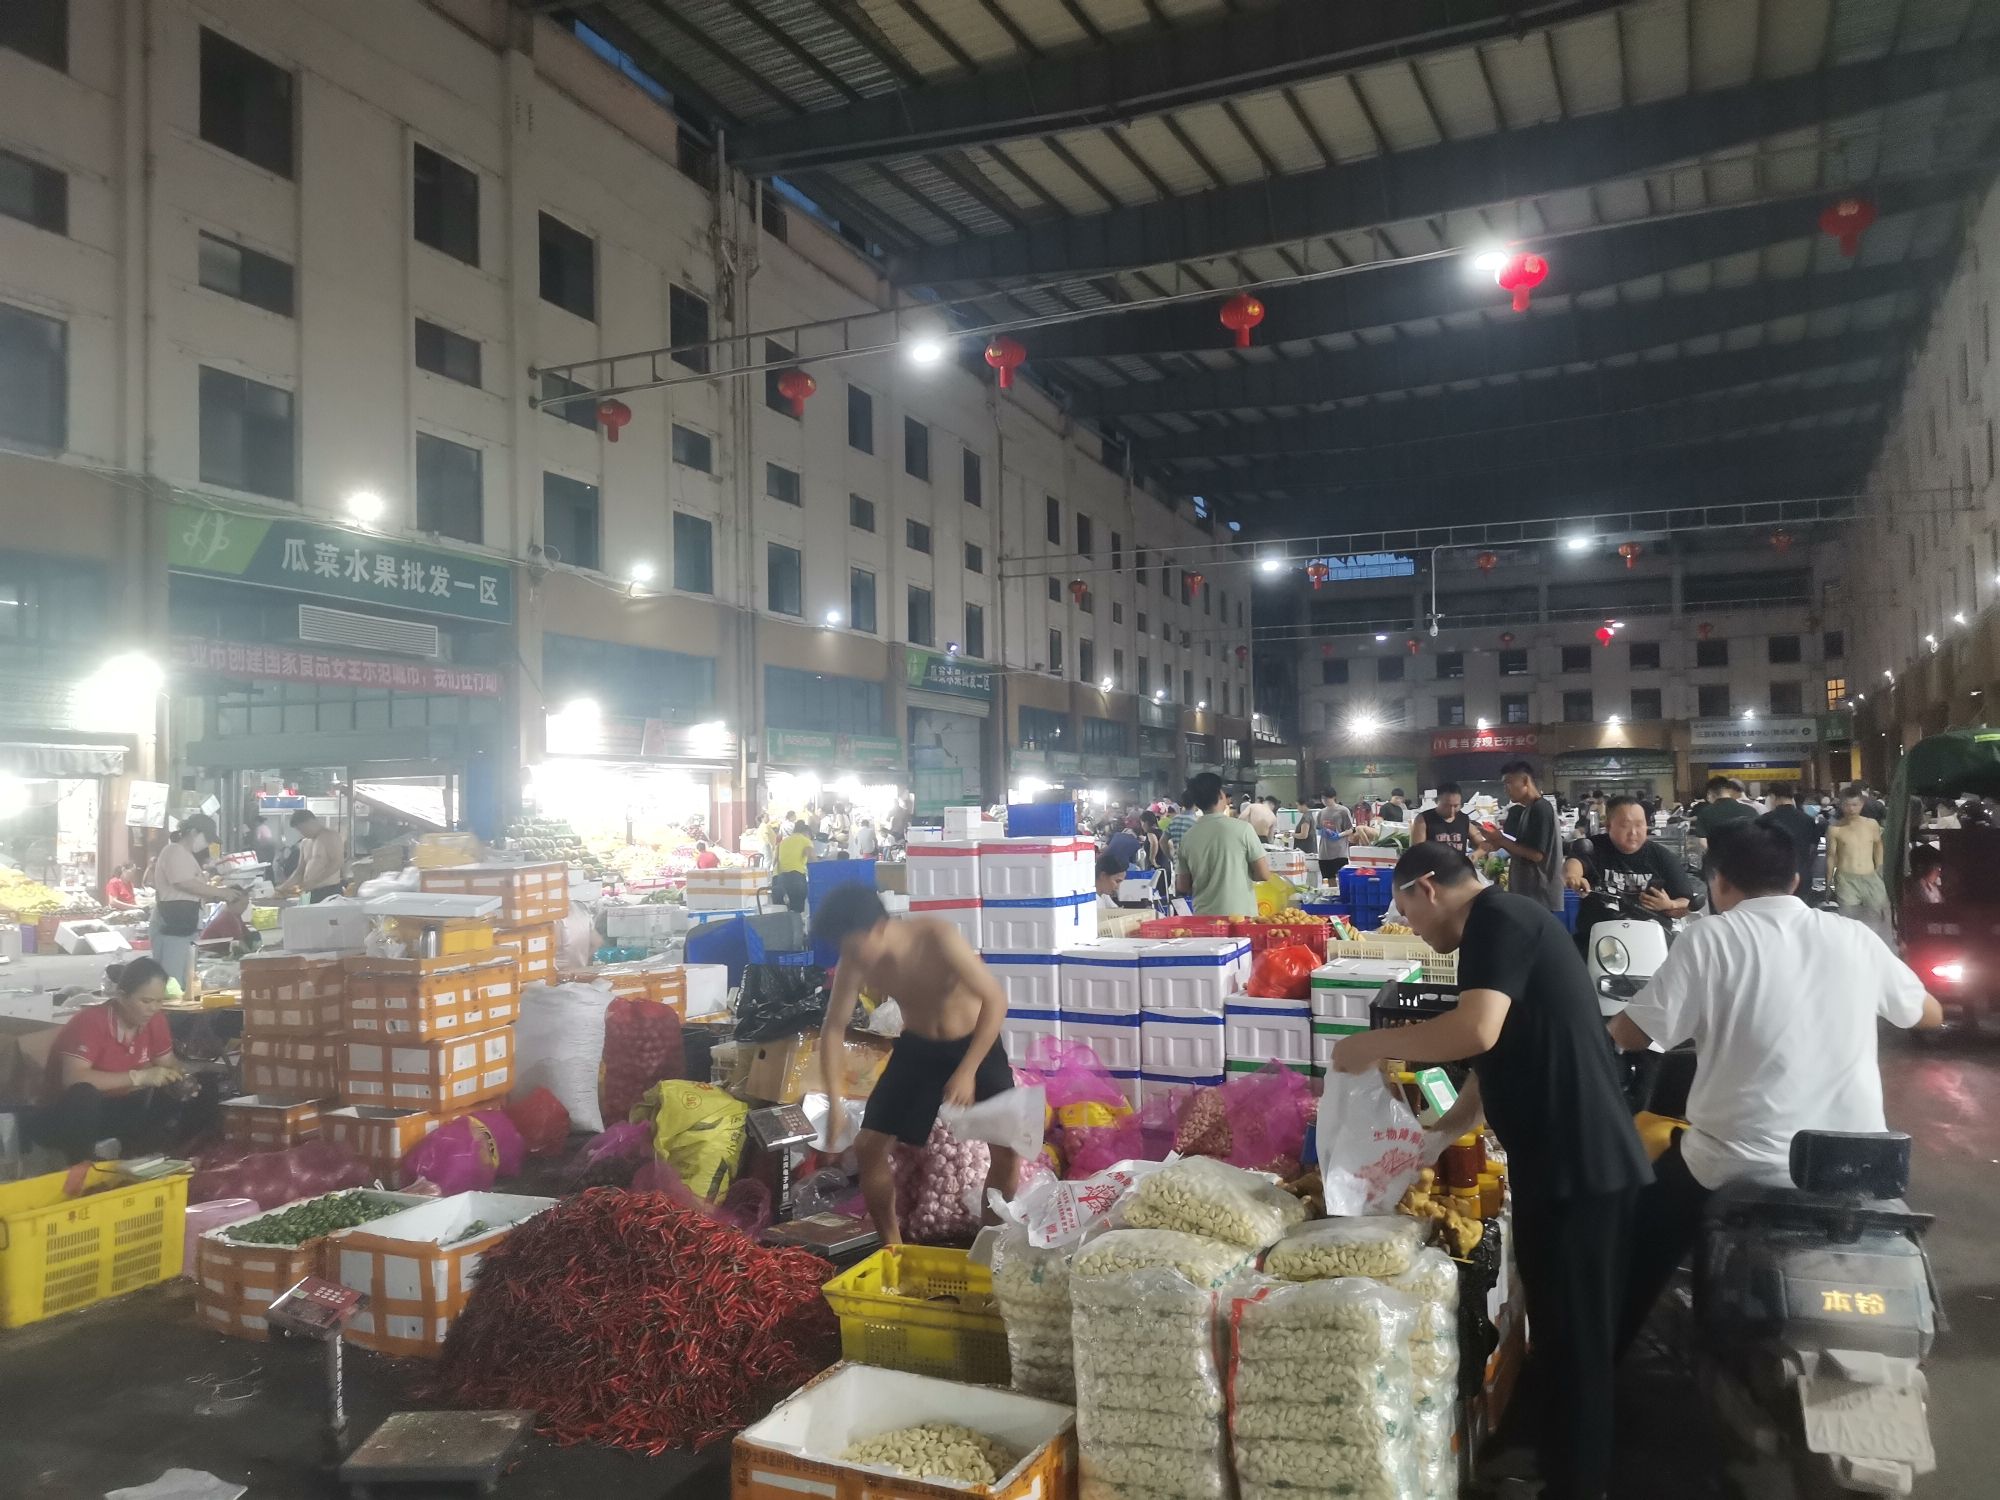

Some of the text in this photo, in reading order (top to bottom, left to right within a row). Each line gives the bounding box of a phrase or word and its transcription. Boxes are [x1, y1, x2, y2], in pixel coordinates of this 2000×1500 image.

[281, 538, 498, 605] 瓜菜水果批发一区
[1448, 736, 1526, 749] 麦当劳现已开业
